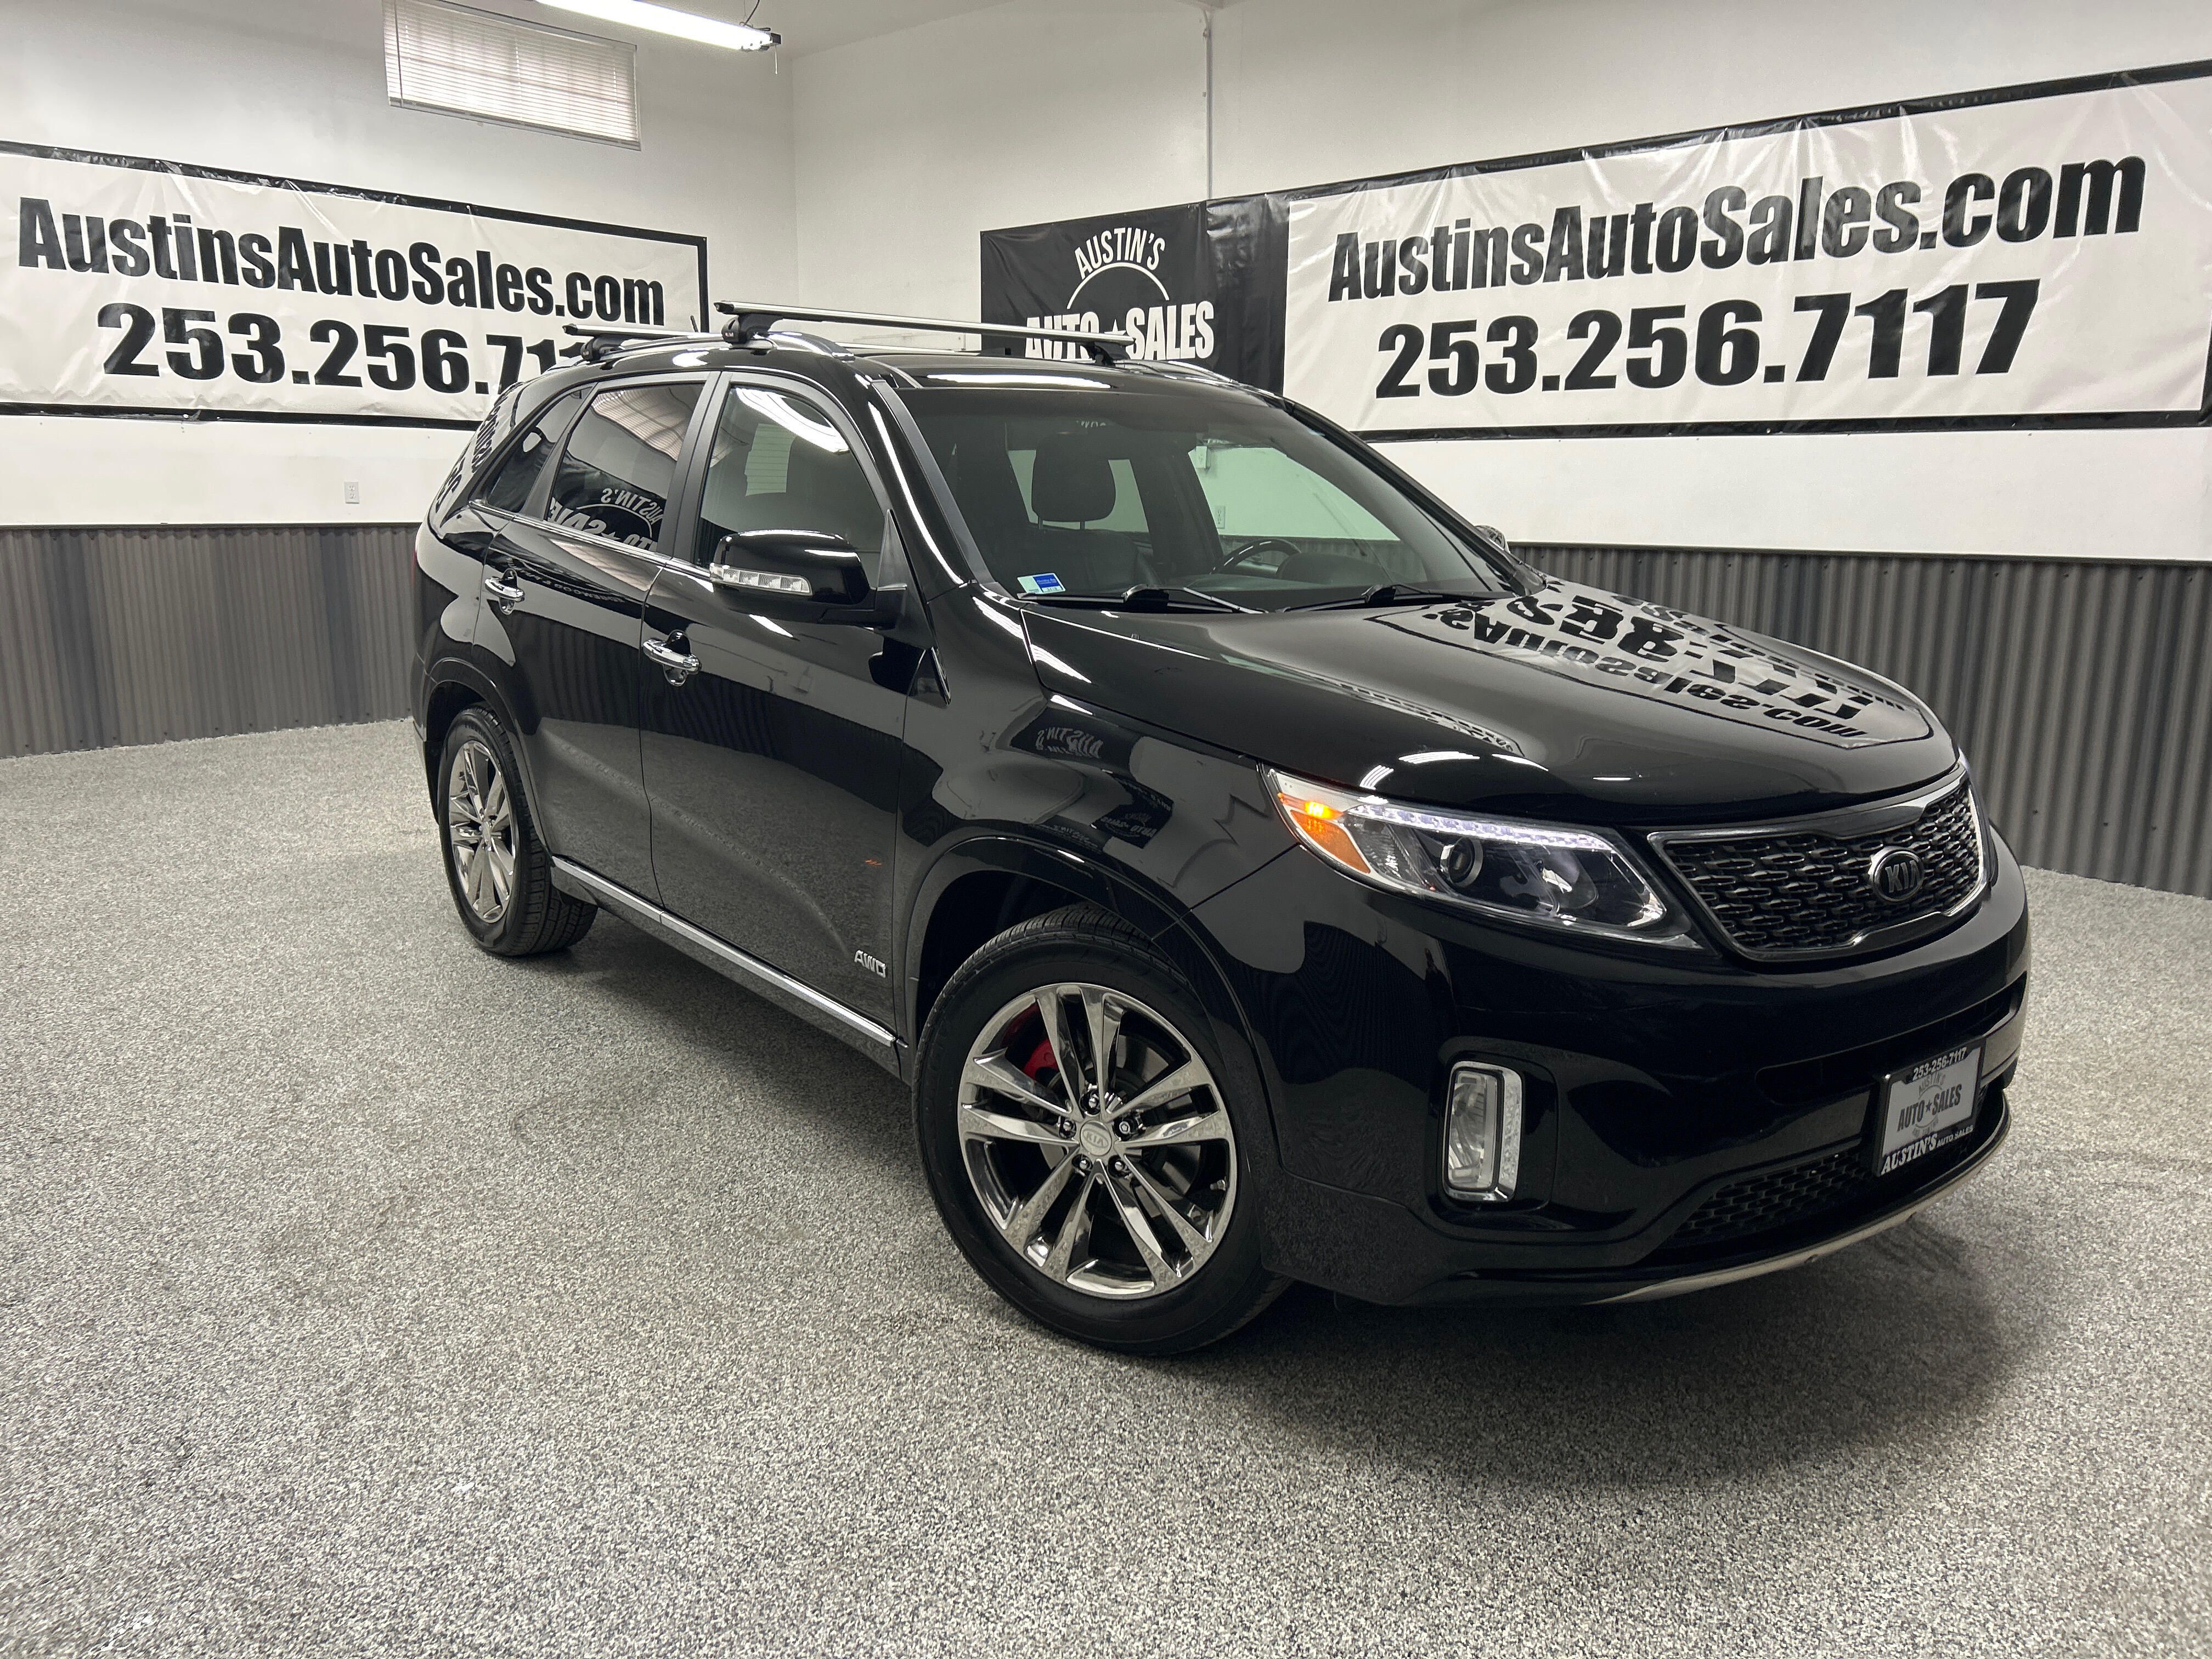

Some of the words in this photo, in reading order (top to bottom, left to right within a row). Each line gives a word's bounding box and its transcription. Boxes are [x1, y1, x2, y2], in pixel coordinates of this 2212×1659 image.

[1074, 227, 1165, 279] AUSTIN'S
[1328, 155, 2146, 302] AustinsAutoSales.com
[19, 196, 664, 325] AustinsAutoSales.com
[97, 302, 584, 395] 253.256.71
[1125, 301, 1214, 360] SALES
[1375, 279, 2041, 399] 253.256.7117
[1885, 860, 1920, 893] KIA
[854, 950, 886, 978] AWD
[1912, 1046, 1967, 1081] 253-256-7117
[1897, 1100, 1925, 1132] AUTO
[1932, 1083, 1962, 1115] SALES
[1086, 1131, 1104, 1147] KIA
[1881, 1133, 1938, 1176] AUSTIN'S
[1937, 1135, 1954, 1148] AUTO
